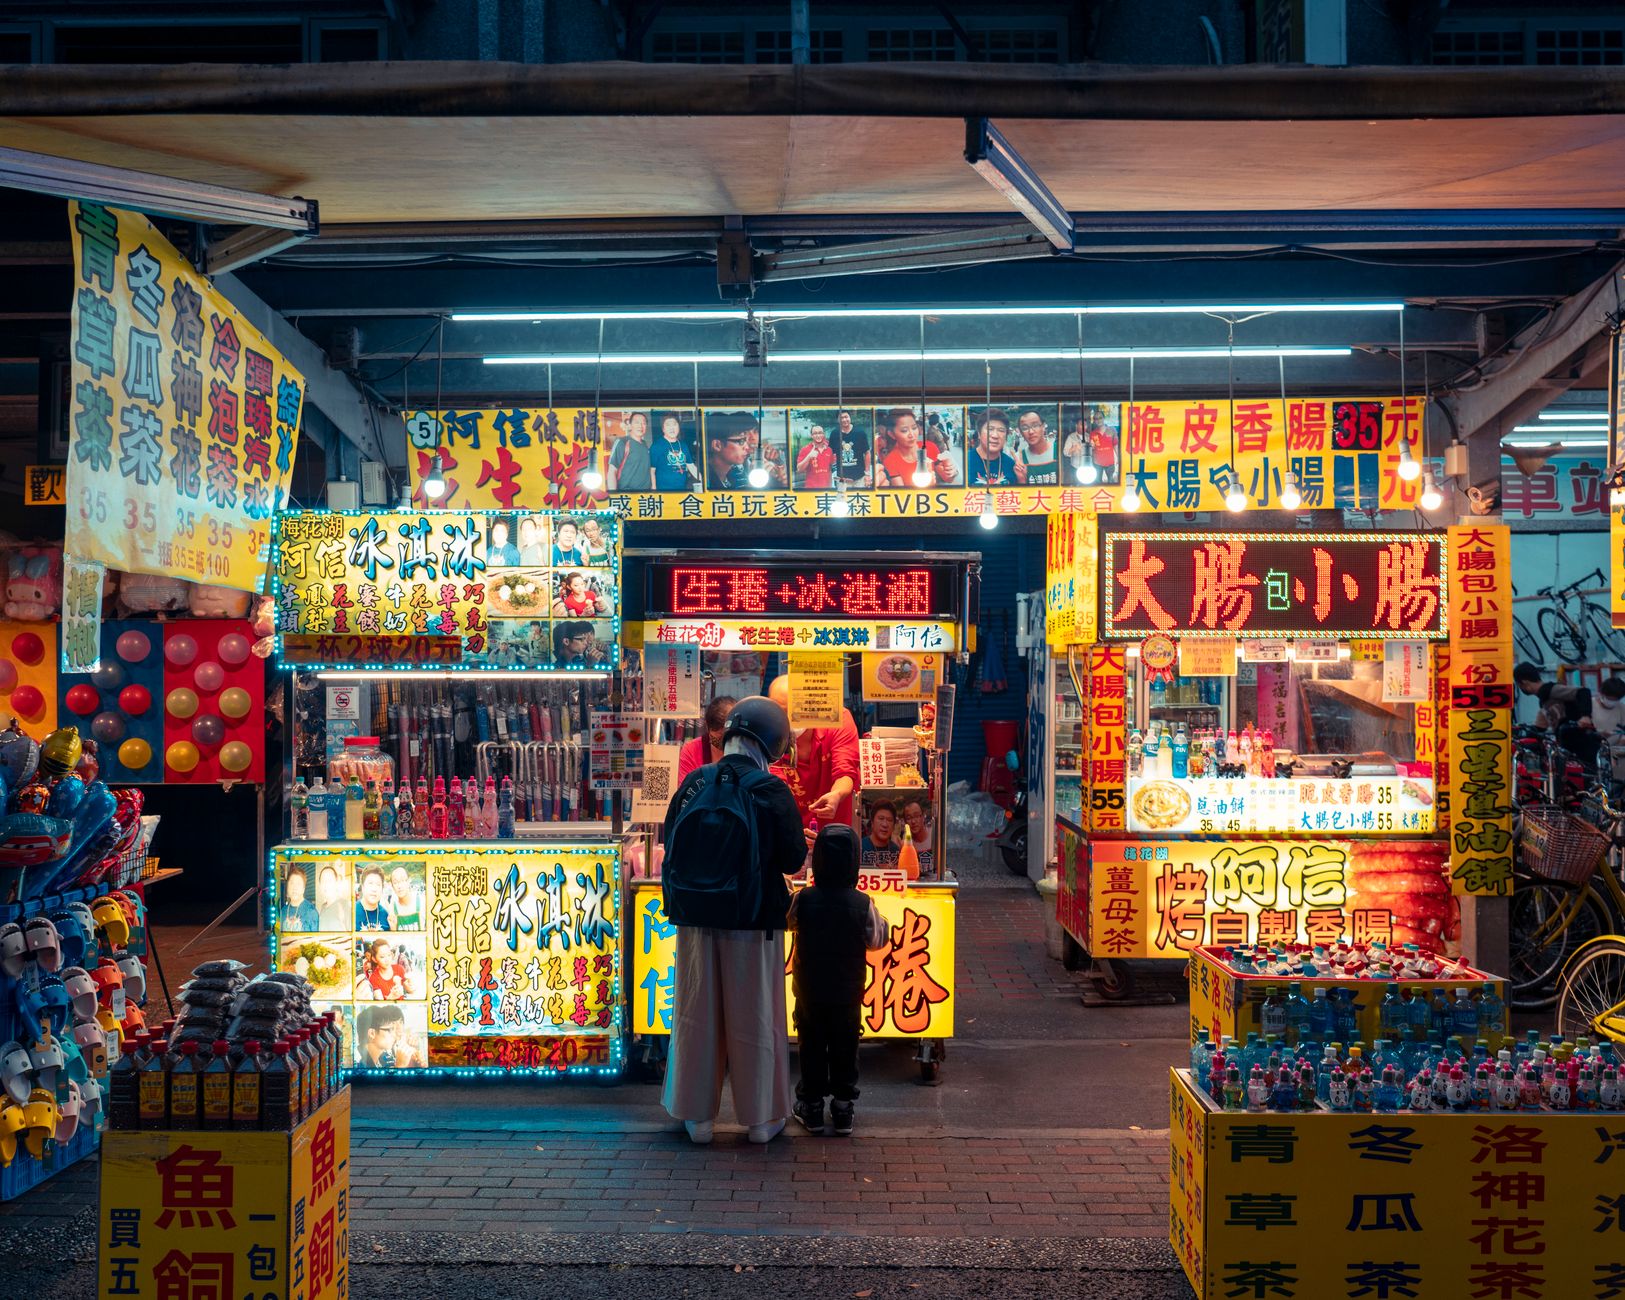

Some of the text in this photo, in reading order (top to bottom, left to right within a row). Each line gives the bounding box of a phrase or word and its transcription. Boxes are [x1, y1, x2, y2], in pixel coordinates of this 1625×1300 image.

[75, 200, 120, 471] 青草茶
[120, 243, 165, 486] 冬瓜茶
[170, 277, 203, 500] 洛神花
[206, 313, 241, 508] 冷泡茶
[243, 347, 273, 520] 彈珠汽水
[123, 498, 157, 533] 35
[176, 507, 195, 540] 35
[207, 518, 232, 549] 35
[281, 516, 344, 539] 梅花湖
[349, 517, 486, 581] 冰淇淋
[279, 539, 347, 579] 阿信
[1113, 540, 1441, 631] 大腸包小腸
[279, 583, 300, 633] 芋頭
[304, 583, 328, 633] 鳳梨
[331, 583, 354, 633] 花豆
[383, 583, 408, 633] 牛奶
[410, 583, 433, 633] 花生
[437, 583, 460, 633] 草莓
[463, 583, 487, 653] 巧克力
[895, 624, 942, 648] 阿信
[1453, 686, 1511, 708] 55
[1200, 819, 1213, 831] 35
[1227, 819, 1240, 831] 45
[1378, 786, 1392, 804] 35
[1378, 813, 1392, 830] 55
[433, 866, 488, 896] 梅花湖
[493, 863, 615, 950] 冰淇淋
[1101, 866, 1139, 954] 薑母茶
[1155, 863, 1208, 951] 烤
[1211, 845, 1346, 908] 阿信
[431, 899, 492, 954] 阿信
[1211, 909, 1392, 948] 自製香腸
[431, 956, 451, 1026] 芋頭
[453, 956, 476, 1026] 鳳梨
[477, 956, 498, 1026] 花豆
[523, 956, 545, 1026] 牛奶
[546, 956, 567, 1026] 花生
[570, 956, 591, 1026] 草莓
[592, 954, 613, 1028] 巧克力
[862, 907, 950, 1034] 捲
[1222, 1124, 1299, 1299] 青草茶
[1344, 1124, 1424, 1299] 冬瓜茶
[1469, 1124, 1548, 1299] 洛神花茶
[293, 1195, 306, 1300] 買五
